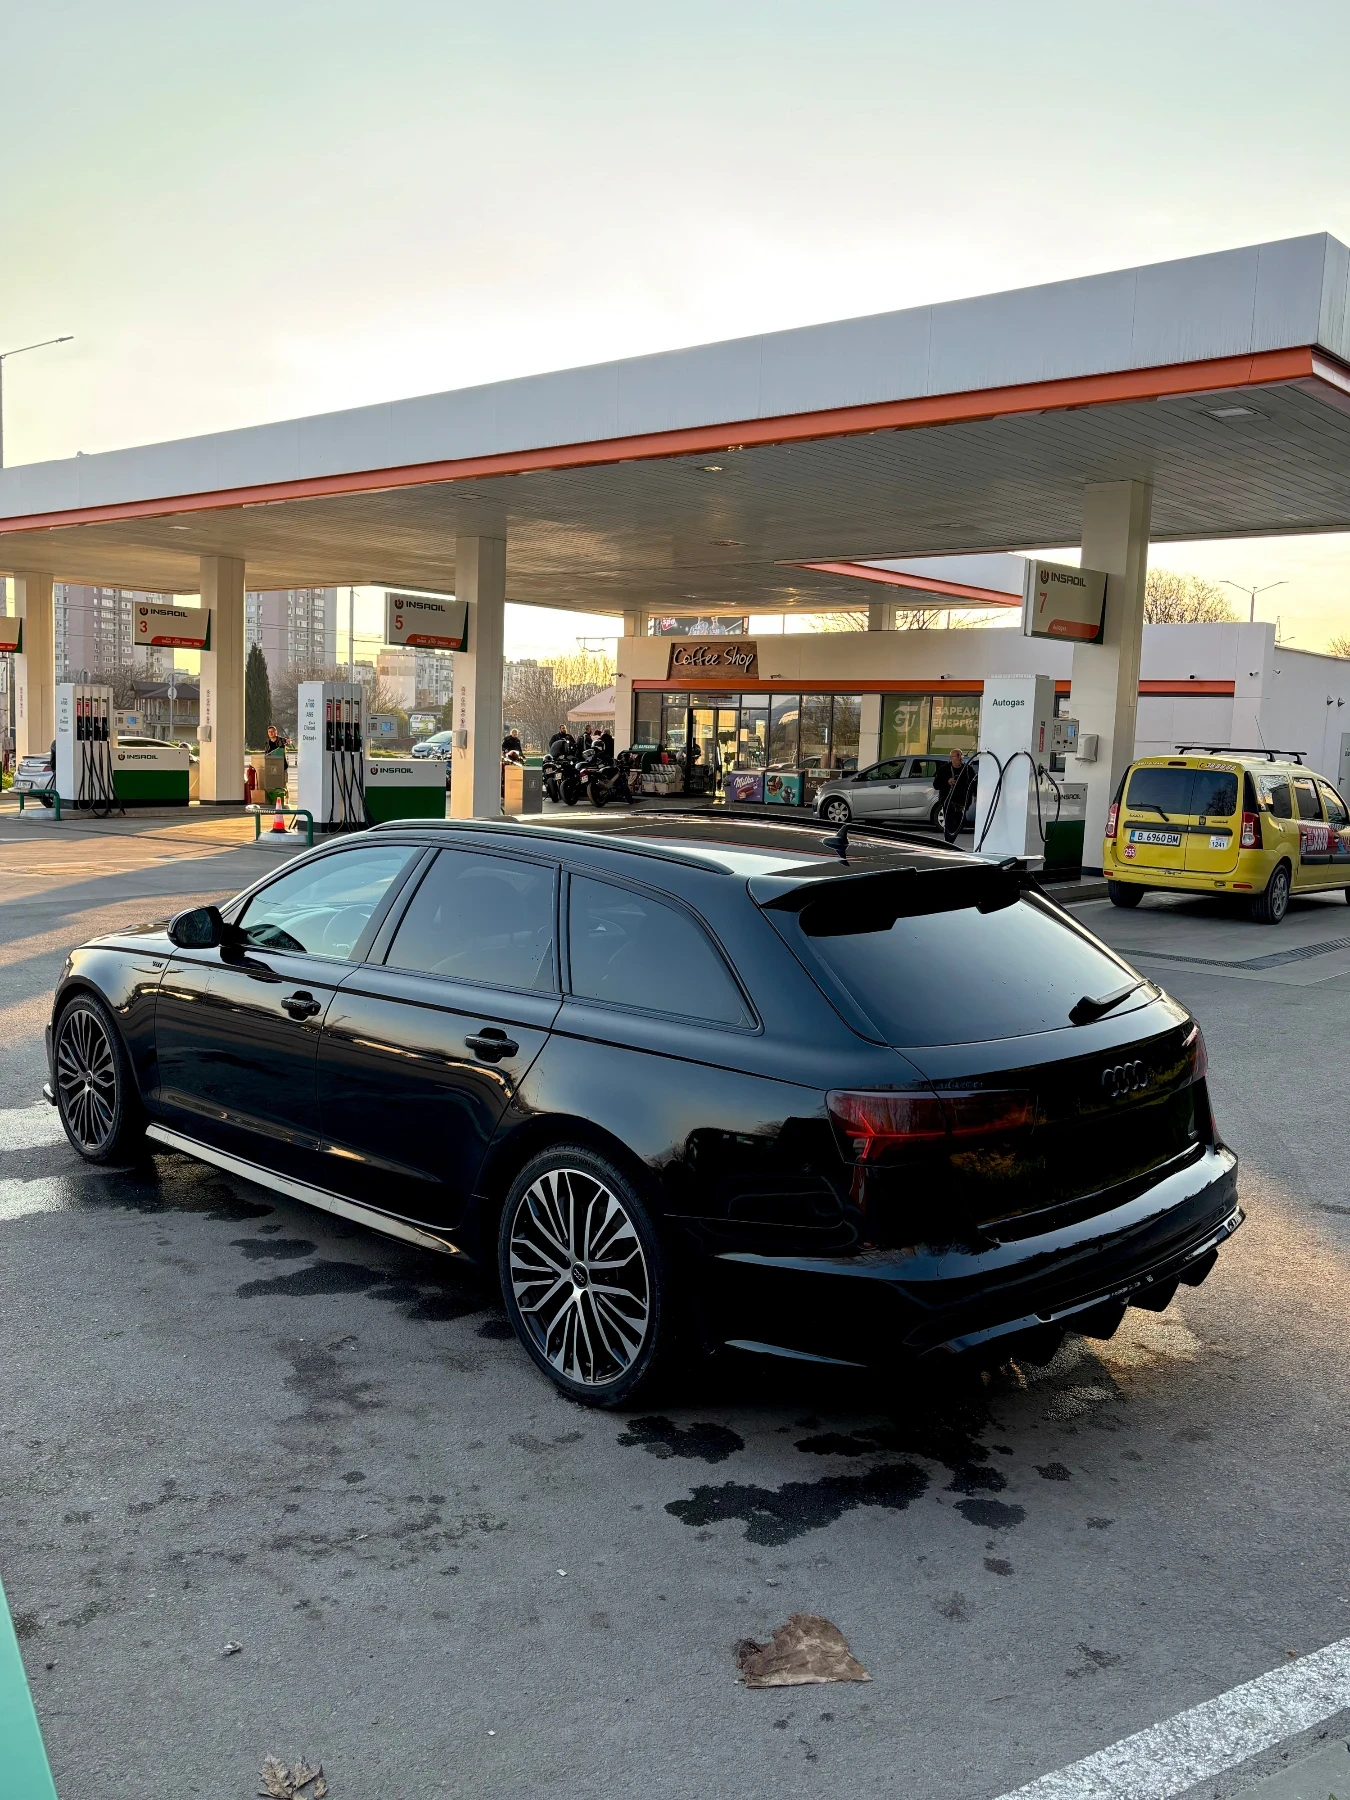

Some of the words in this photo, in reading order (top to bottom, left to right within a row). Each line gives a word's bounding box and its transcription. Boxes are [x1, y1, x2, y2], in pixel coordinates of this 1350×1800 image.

[1051, 572, 1087, 587] INSAOIL
[406, 600, 446, 612] INSAOIL
[1040, 592, 1048, 613] 7
[150, 608, 188, 618] INSAOIL
[140, 620, 148, 633] 3
[395, 615, 404, 630] 5
[673, 647, 719, 666] Coffee
[723, 646, 754, 673] Shop
[992, 699, 1025, 708] Autogas
[934, 706, 979, 717] ЗАРЕДИ
[733, 776, 754, 788] Milka
[1147, 833, 1166, 843] 6960
[1167, 834, 1179, 844] BM
[1124, 848, 1136, 856] 255
